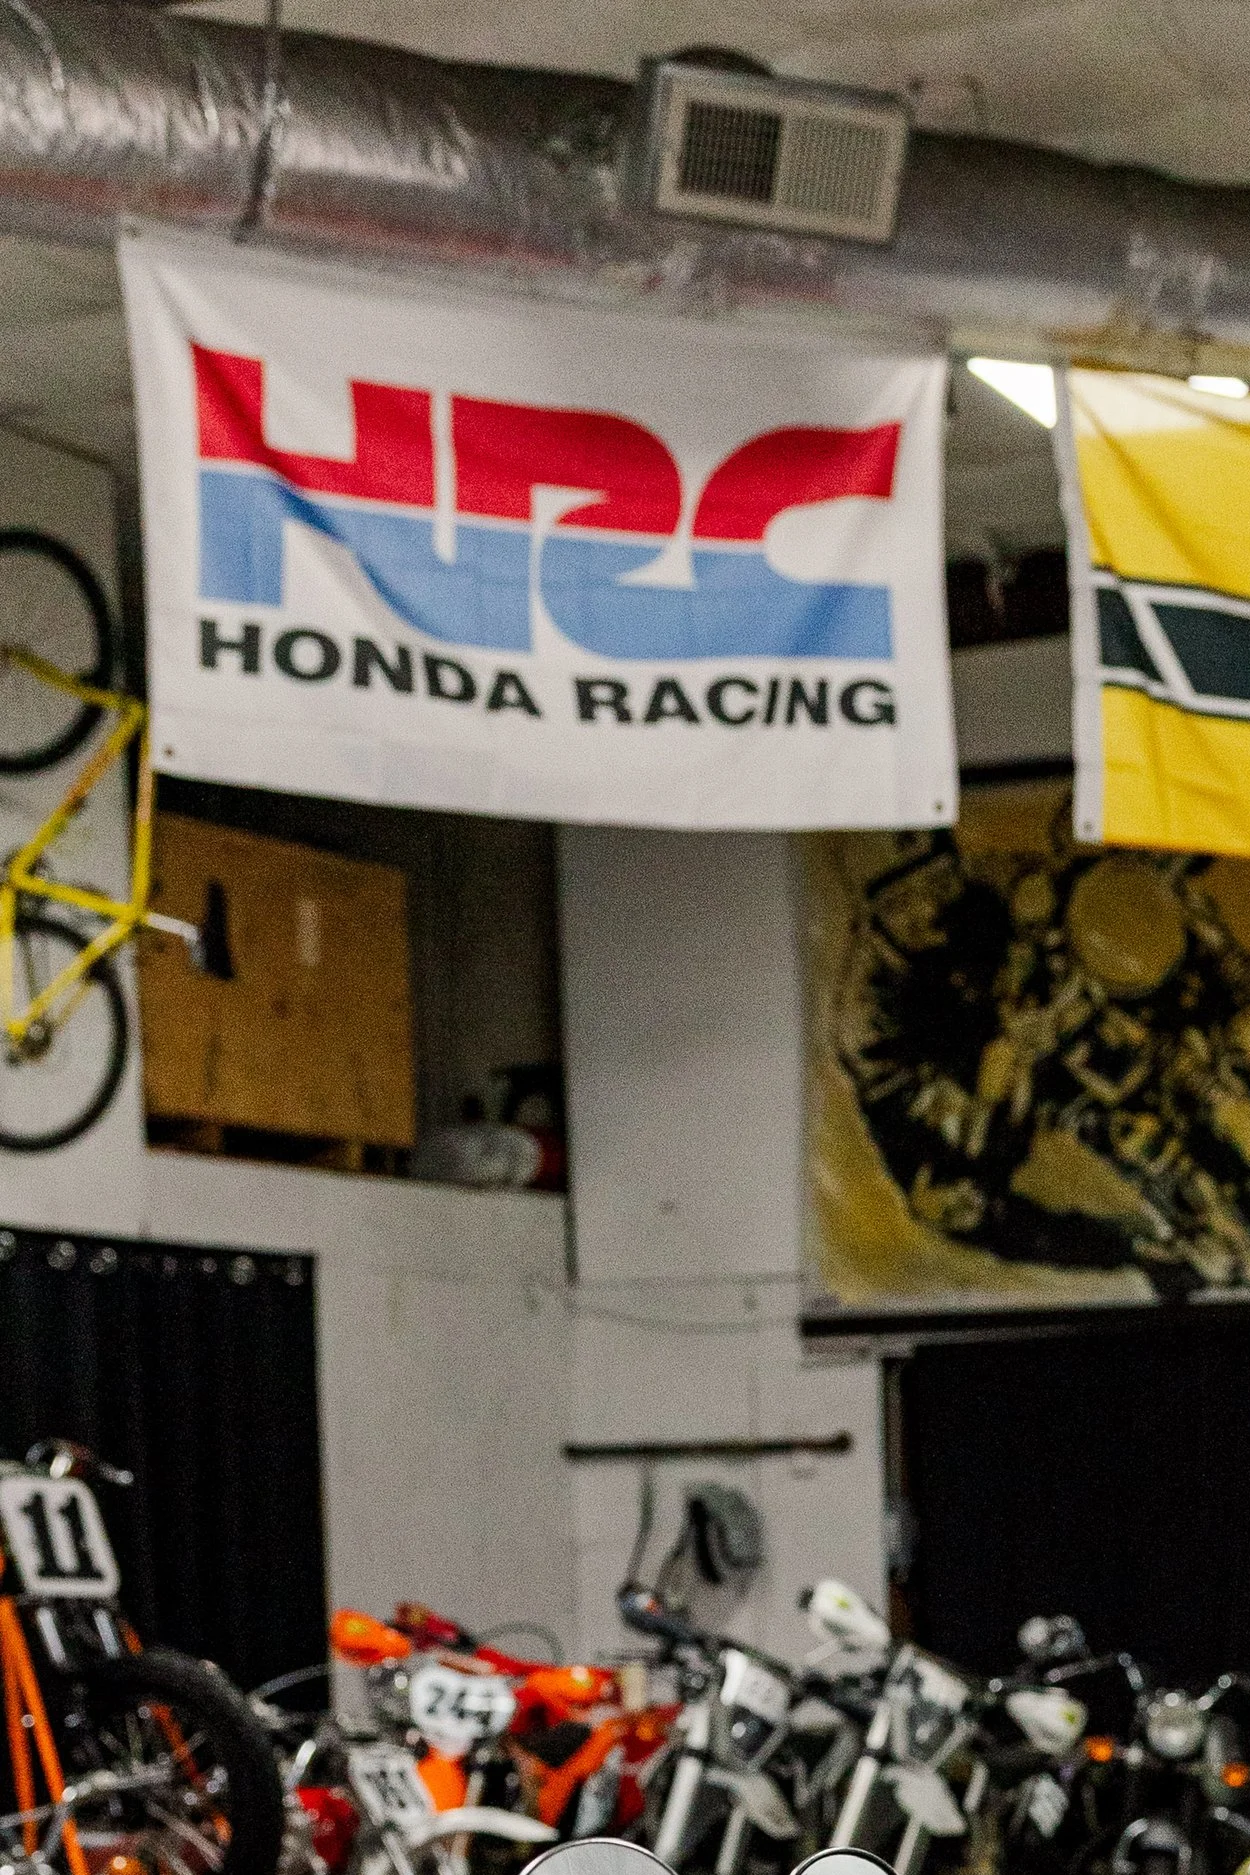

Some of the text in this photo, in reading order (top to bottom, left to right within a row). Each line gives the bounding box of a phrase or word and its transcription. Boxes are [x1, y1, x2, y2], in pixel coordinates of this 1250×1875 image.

[191, 340, 902, 661] HRC
[199, 619, 897, 728] HONDA RACING
[22, 1490, 103, 1579] 11
